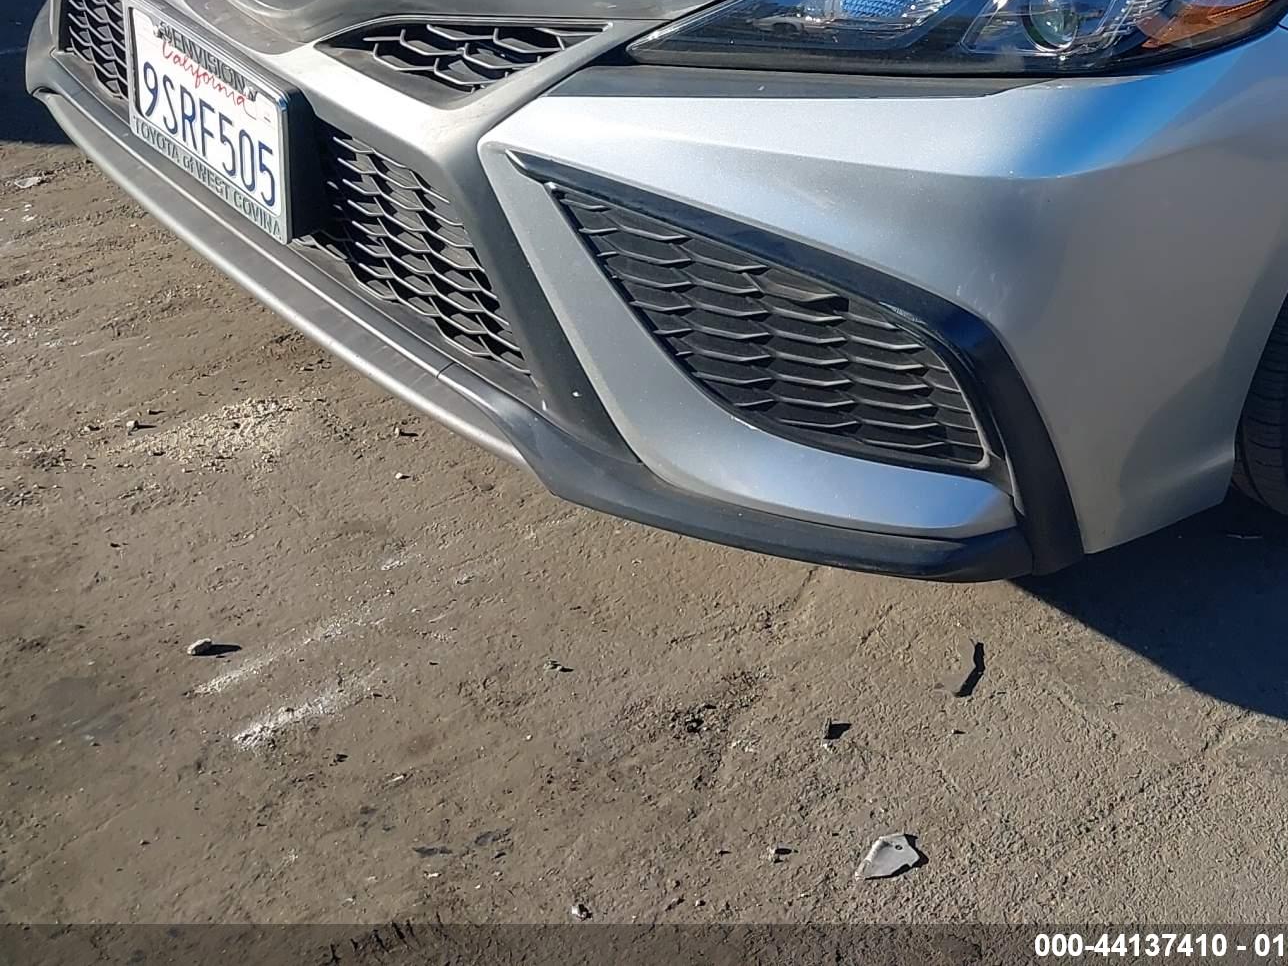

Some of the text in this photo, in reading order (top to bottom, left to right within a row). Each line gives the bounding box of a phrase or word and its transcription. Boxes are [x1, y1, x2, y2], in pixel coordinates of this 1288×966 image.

[162, 39, 256, 121] California
[172, 27, 246, 95] ENVISION
[133, 116, 180, 162] TOYOTA
[194, 162, 230, 201] WEST
[233, 190, 282, 240] COVINA
[143, 61, 276, 208] 9SRF505
